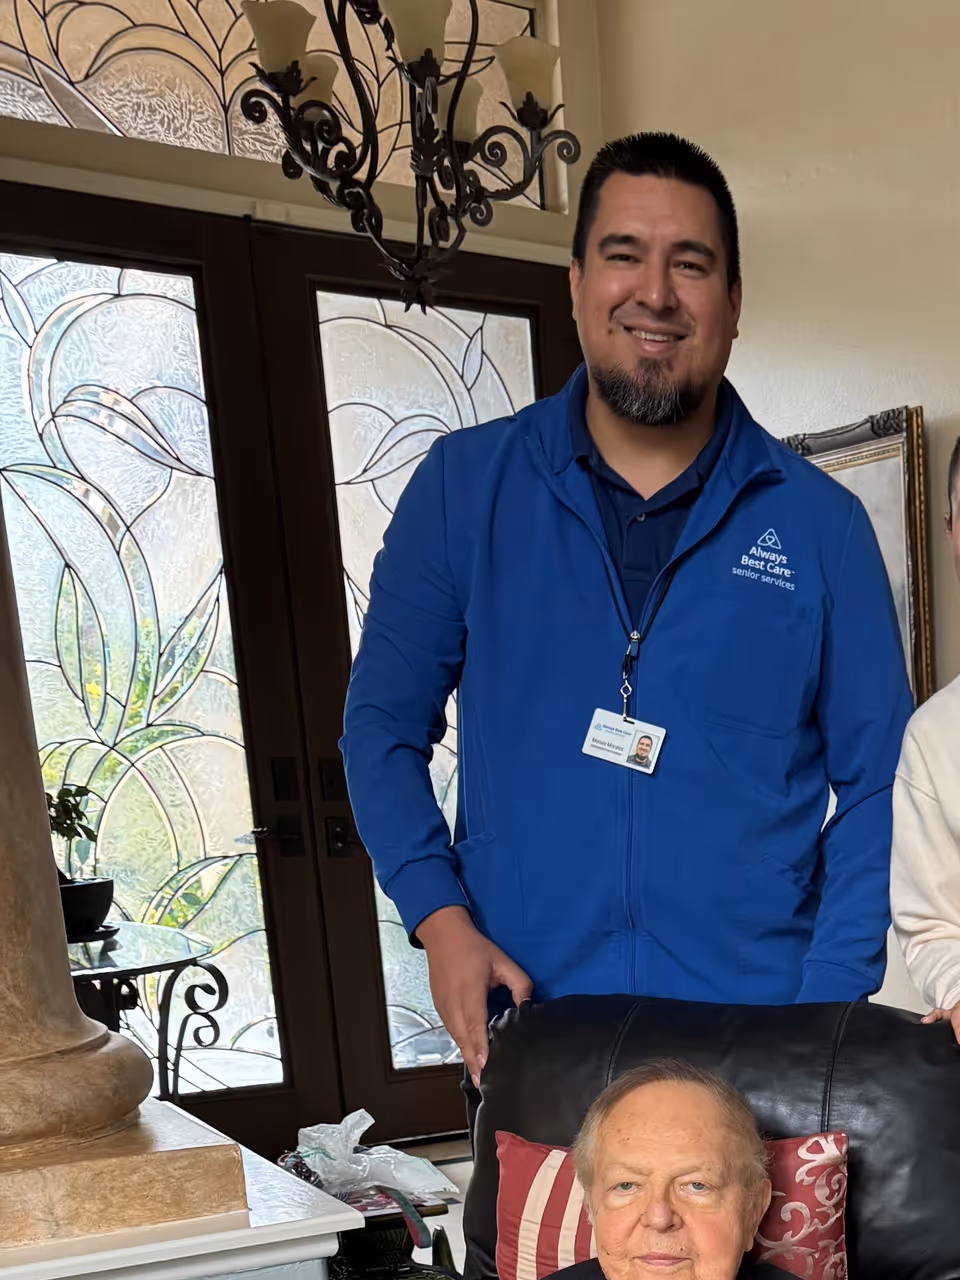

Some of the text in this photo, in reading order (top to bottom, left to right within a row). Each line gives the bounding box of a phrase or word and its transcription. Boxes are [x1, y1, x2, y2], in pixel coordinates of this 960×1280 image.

[741, 554, 765, 570] Best
[749, 546, 788, 564] Always
[732, 567, 795, 590] senior services
